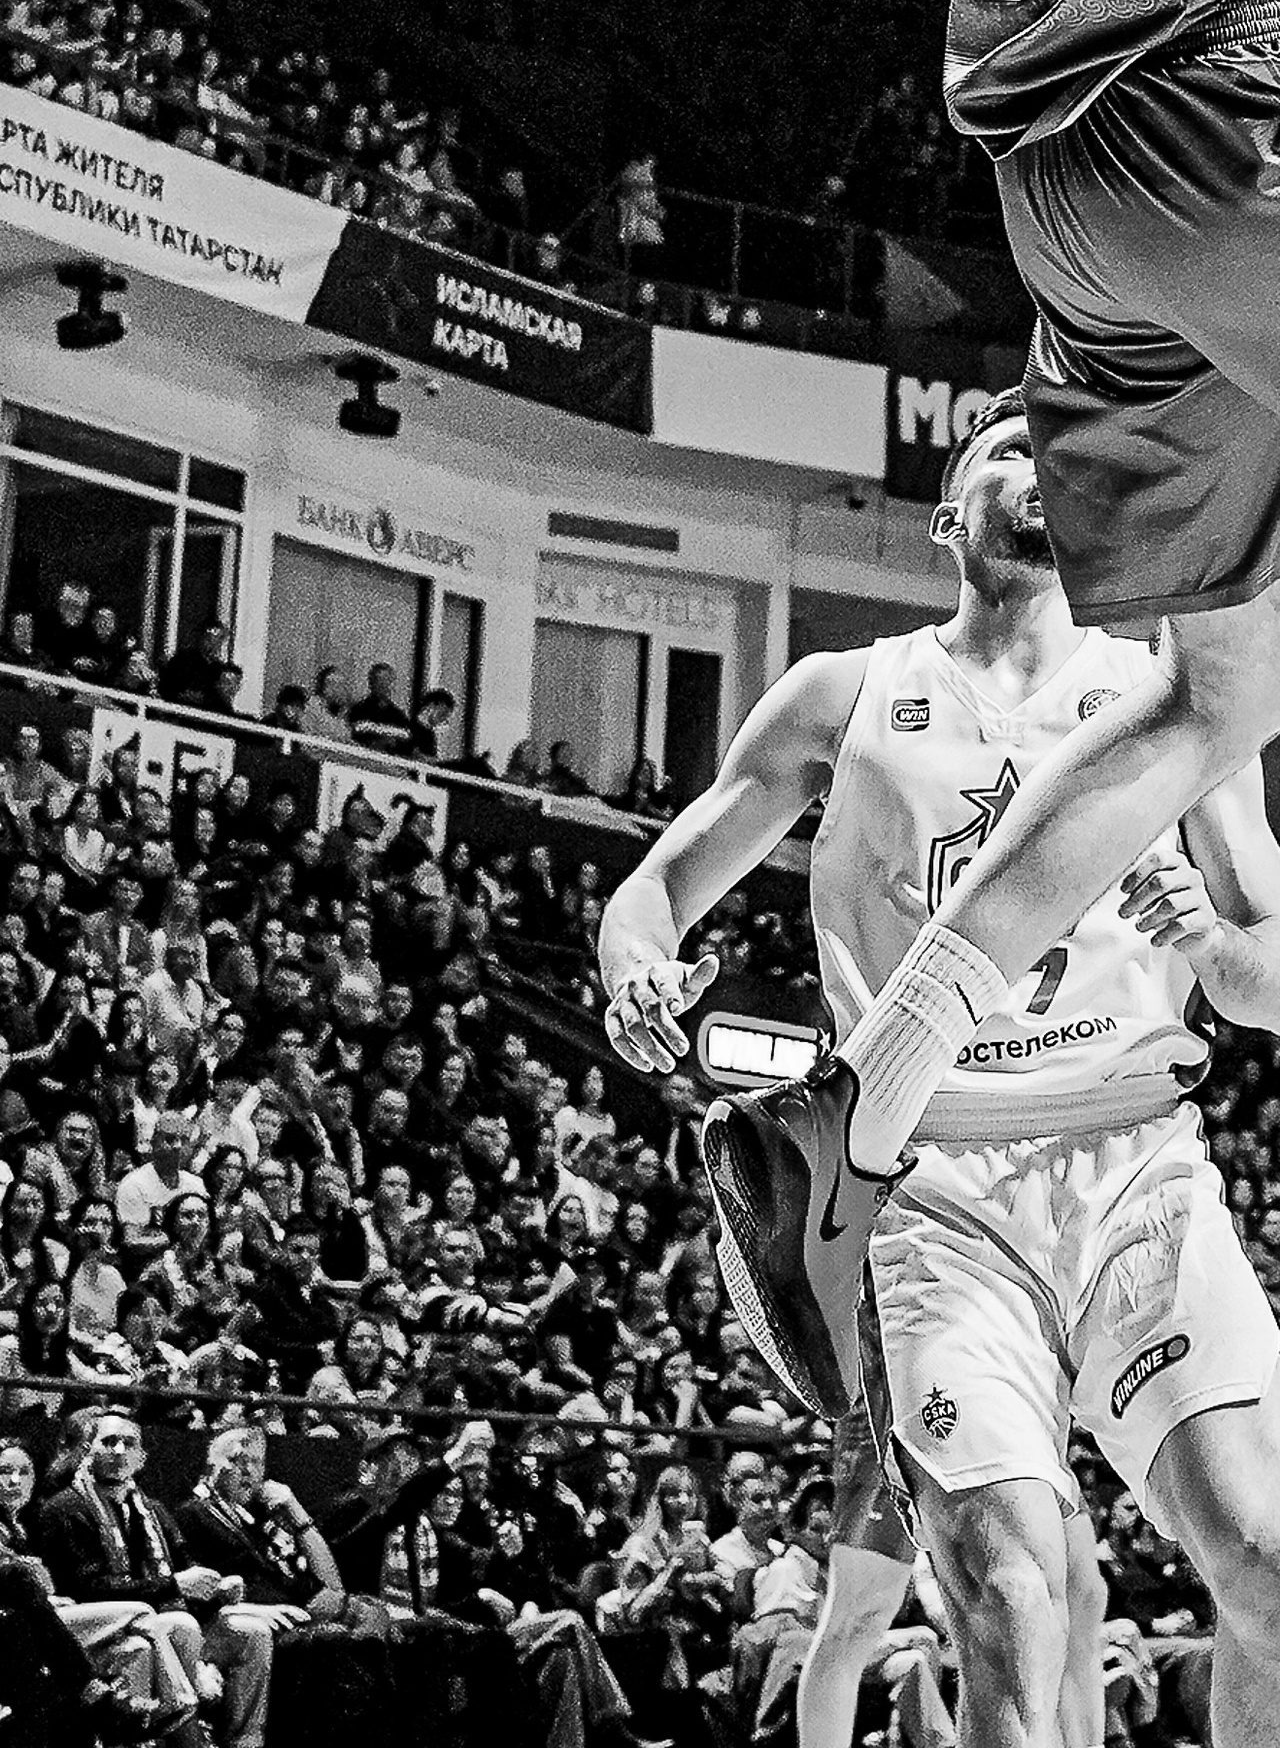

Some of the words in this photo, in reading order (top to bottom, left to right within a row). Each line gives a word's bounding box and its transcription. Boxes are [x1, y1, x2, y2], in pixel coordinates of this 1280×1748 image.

[54, 138, 165, 201] ЖИТЕЛЯ
[146, 214, 285, 286] ТАТАРСТАН
[436, 273, 583, 351] ИСЛАМСКАЯ
[432, 318, 509, 370] КАРТА
[899, 707, 928, 722] WIN
[954, 1016, 1117, 1065] остелеком
[924, 1403, 956, 1421] CSKA
